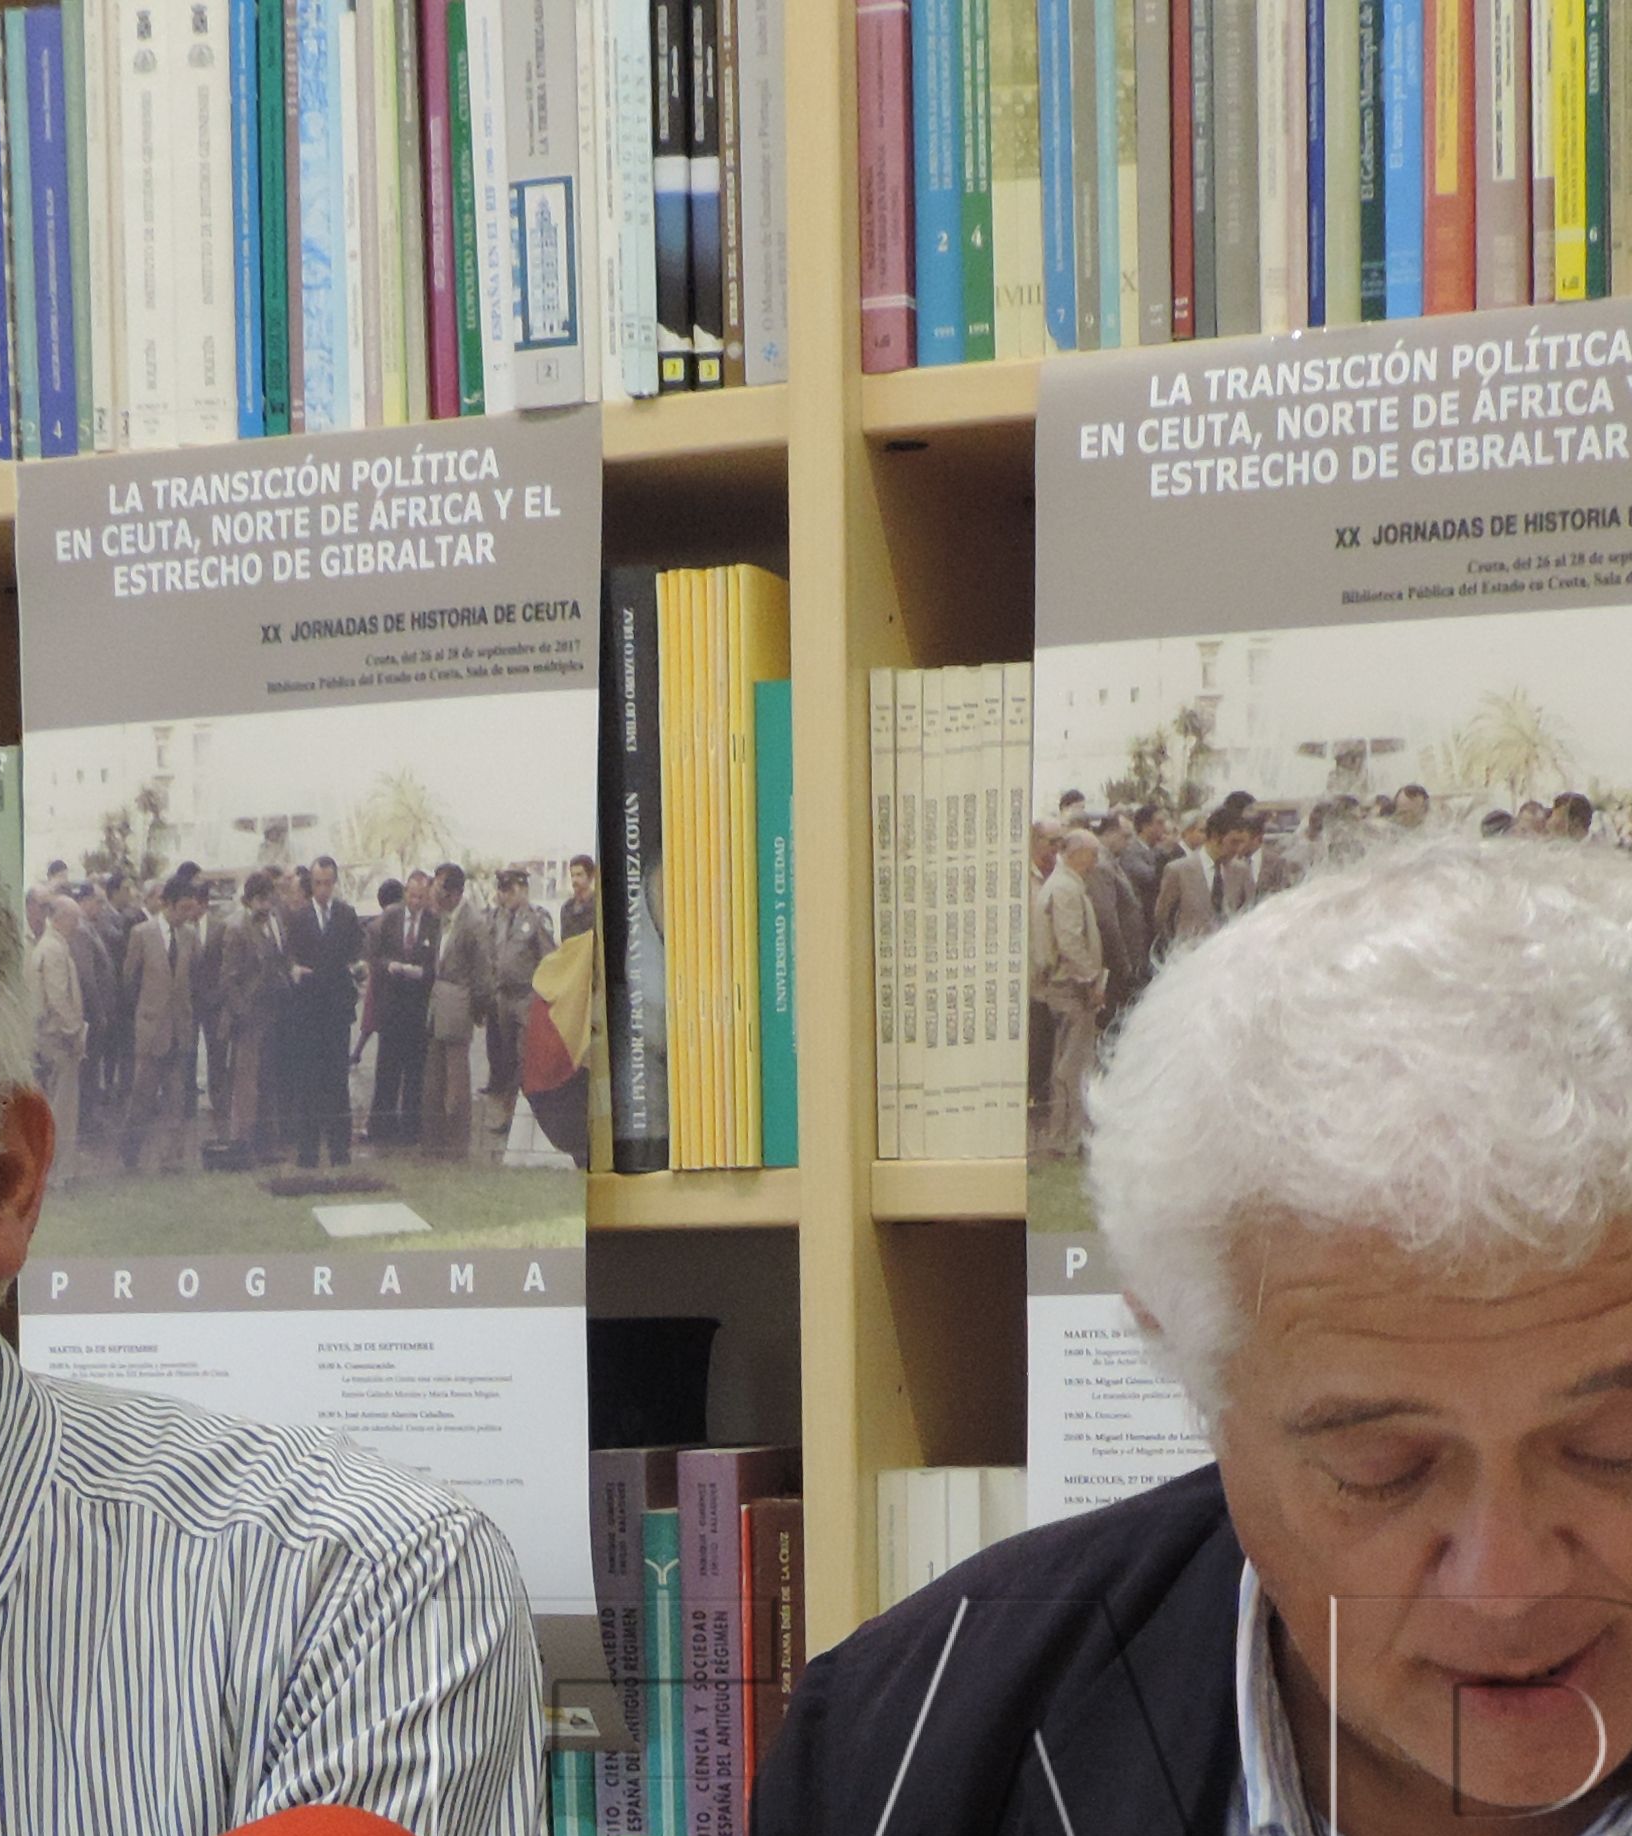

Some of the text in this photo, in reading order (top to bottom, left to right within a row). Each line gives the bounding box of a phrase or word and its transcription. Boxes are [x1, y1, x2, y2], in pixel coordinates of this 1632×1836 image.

[1150, 324, 1632, 408] LA TRANSICIÓN POLÍTICA
[1080, 422, 1125, 459] EN
[1137, 410, 1263, 454] CEUTA,
[1277, 396, 1399, 441] NORTE
[1412, 390, 1460, 429] DE
[1472, 376, 1615, 424] ÁFRICA
[108, 443, 500, 515] LA TRANSICIÓN POLÍTICA
[1150, 423, 1630, 498] ESTRECHO DE GIBRALTAR
[55, 484, 561, 562] EN CEUTA, NORTE DE ÁFRICA Y EL
[1335, 526, 1361, 550] XX
[1372, 516, 1484, 547] JORNADAS
[1490, 514, 1518, 537] DE
[1523, 507, 1622, 534] HISTORIA
[113, 531, 496, 597] ESTRECHO DE GIBRALTAR
[260, 599, 581, 645] XX JORNADAS DE HISTORIA DE CEUTA
[621, 791, 642, 850] COTÁN
[774, 836, 787, 1013] UNIVERSIDAD Y CIUDAD
[709, 1610, 730, 1675] RÉGIMEN
[691, 1610, 711, 1793] CIENCIA Y SOCIEDAD
[709, 1678, 734, 1748] ANTIGUO
[716, 1751, 733, 1778] DEL
